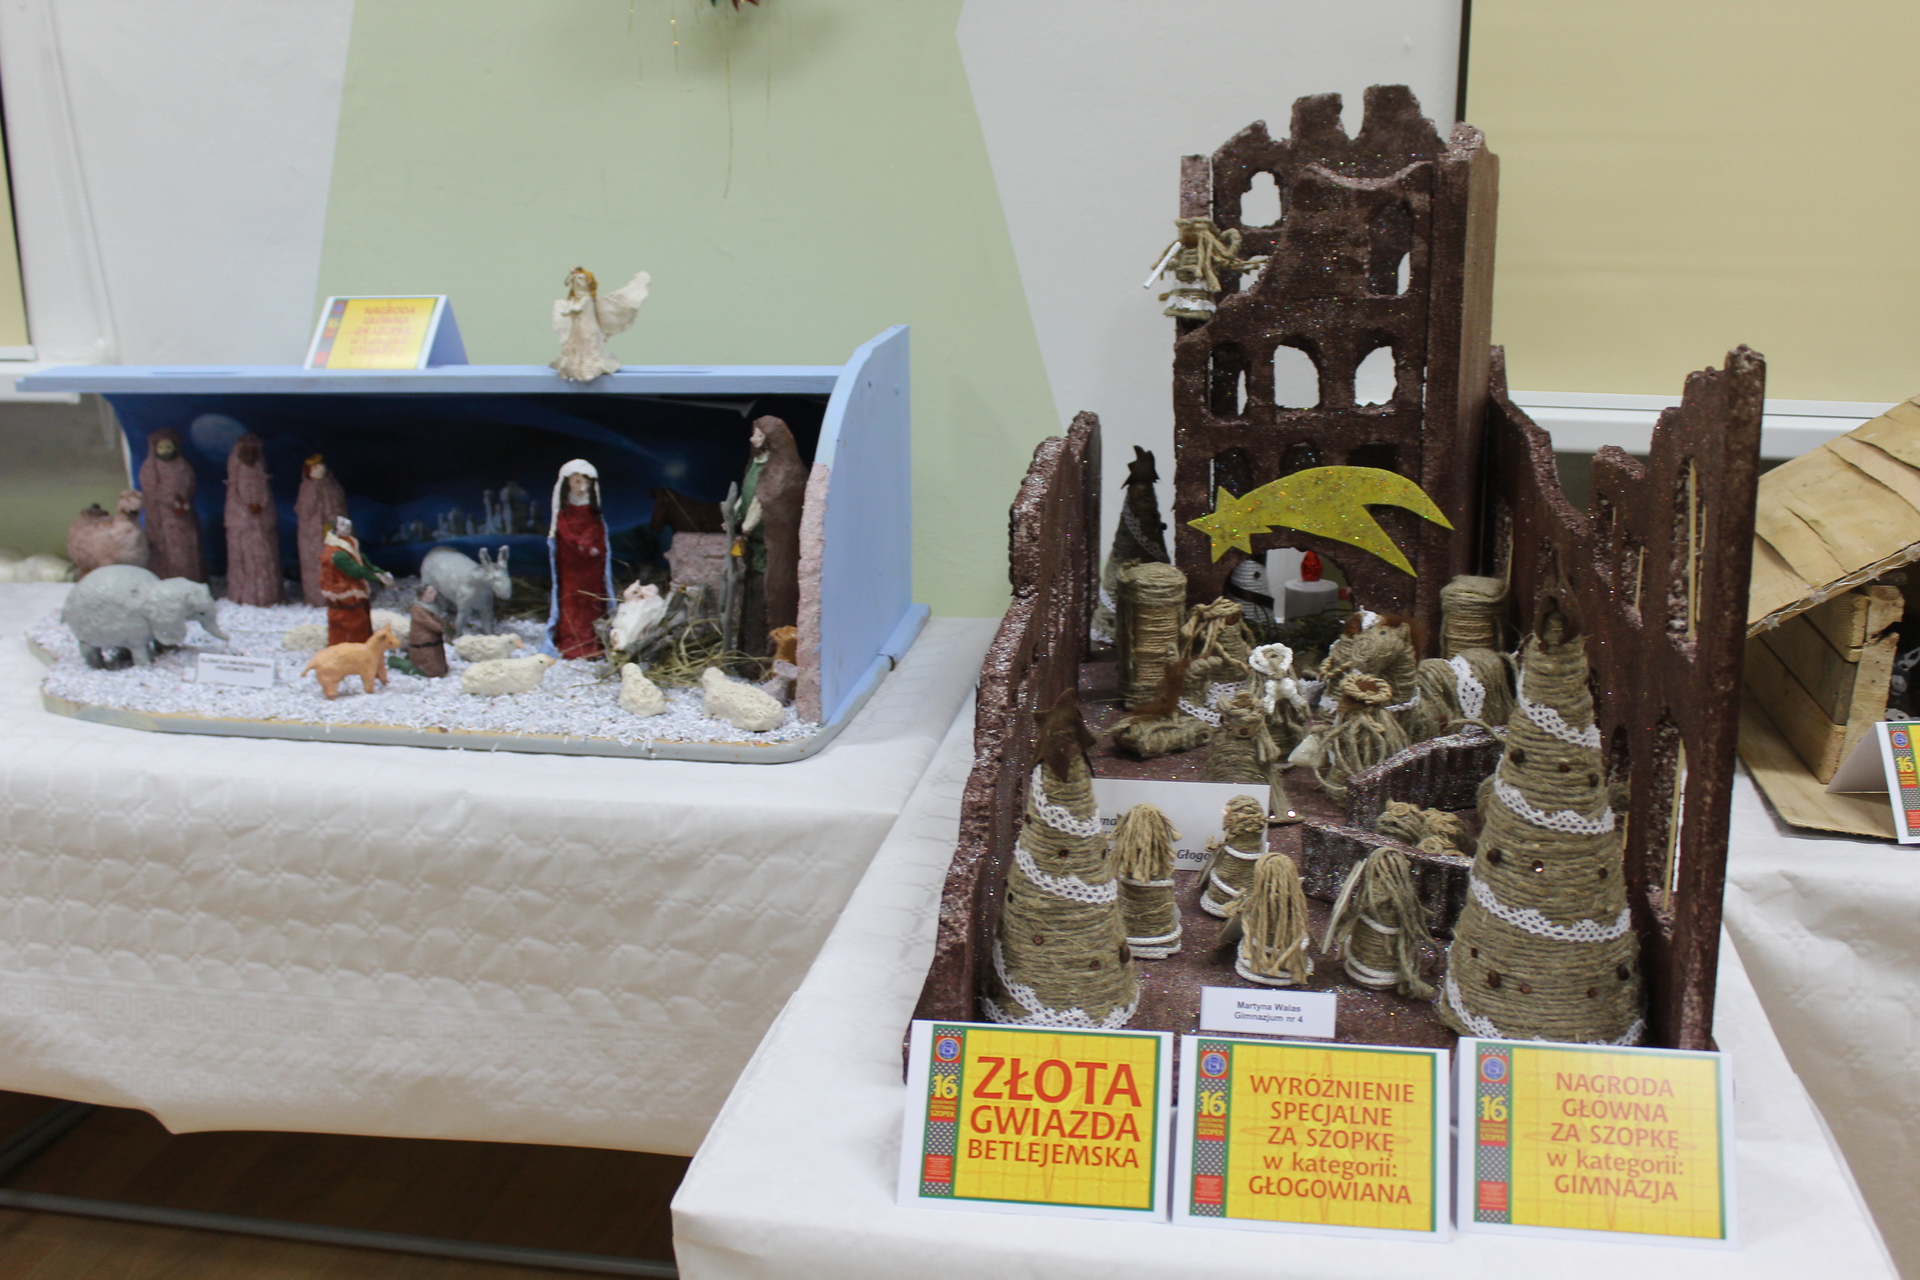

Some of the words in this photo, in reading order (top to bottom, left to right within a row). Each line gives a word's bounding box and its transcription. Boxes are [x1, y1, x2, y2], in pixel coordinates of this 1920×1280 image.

[1896, 756, 1914, 772] 16
[1234, 1011, 1284, 1022] Gimnazjum
[1297, 1015, 1303, 1023] 4
[1237, 1001, 1272, 1011] Martyna
[1275, 1003, 1301, 1012] Walas
[933, 1073, 958, 1099] 16
[973, 1056, 1142, 1107] ZŁOTA
[1250, 1073, 1414, 1103] WYRÓŻNIENIE
[1556, 1072, 1675, 1098] NAGRODA
[1200, 1090, 1227, 1117] 16
[1270, 1101, 1392, 1126] SPECJALNE
[1480, 1094, 1508, 1122] 16
[1562, 1094, 1668, 1123] GŁÓWNA
[970, 1105, 1141, 1142] GWIAZDA
[1267, 1126, 1297, 1146] ZA
[1306, 1128, 1394, 1158] SZOPKĘ
[1551, 1122, 1581, 1143] ZA
[1590, 1125, 1679, 1155] SZOPKĘ
[968, 1139, 1140, 1168] BETLEJEMSKA
[1262, 1156, 1283, 1170] w
[1292, 1151, 1397, 1181] kategorii:
[1547, 1152, 1567, 1167] w
[1577, 1149, 1683, 1178] kategorii:
[1248, 1175, 1412, 1204] GŁOGOWIANA
[1554, 1174, 1679, 1204] GIMNAZJA
